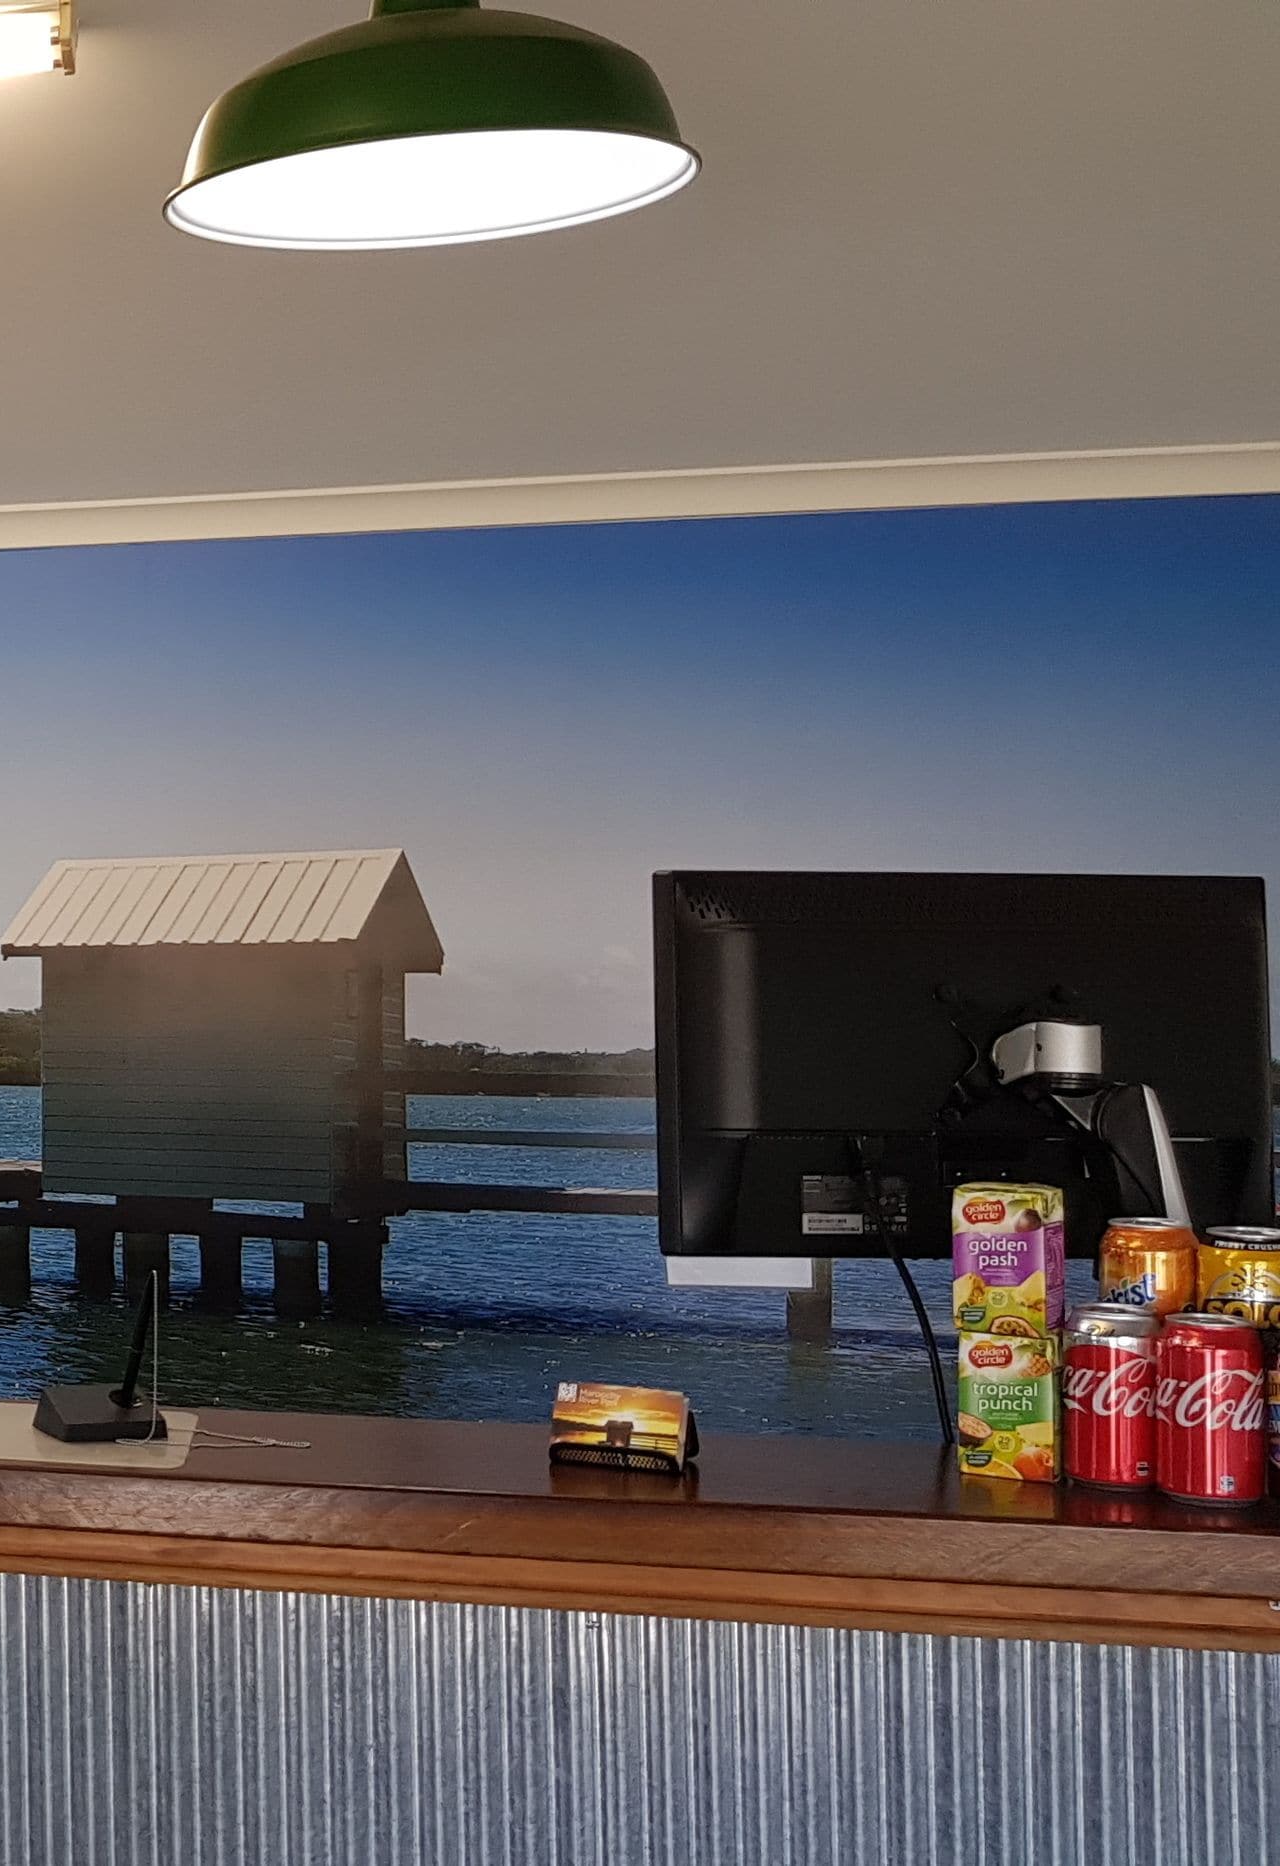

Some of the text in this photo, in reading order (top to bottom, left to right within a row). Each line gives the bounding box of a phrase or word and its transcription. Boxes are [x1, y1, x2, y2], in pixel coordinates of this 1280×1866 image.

[965, 1202, 1002, 1216] golden
[969, 1237, 1028, 1255] golden
[978, 1251, 1018, 1269] pash
[971, 1347, 1009, 1358] golden
[973, 1382, 1038, 1399] tropical
[978, 1397, 1033, 1413] punch
